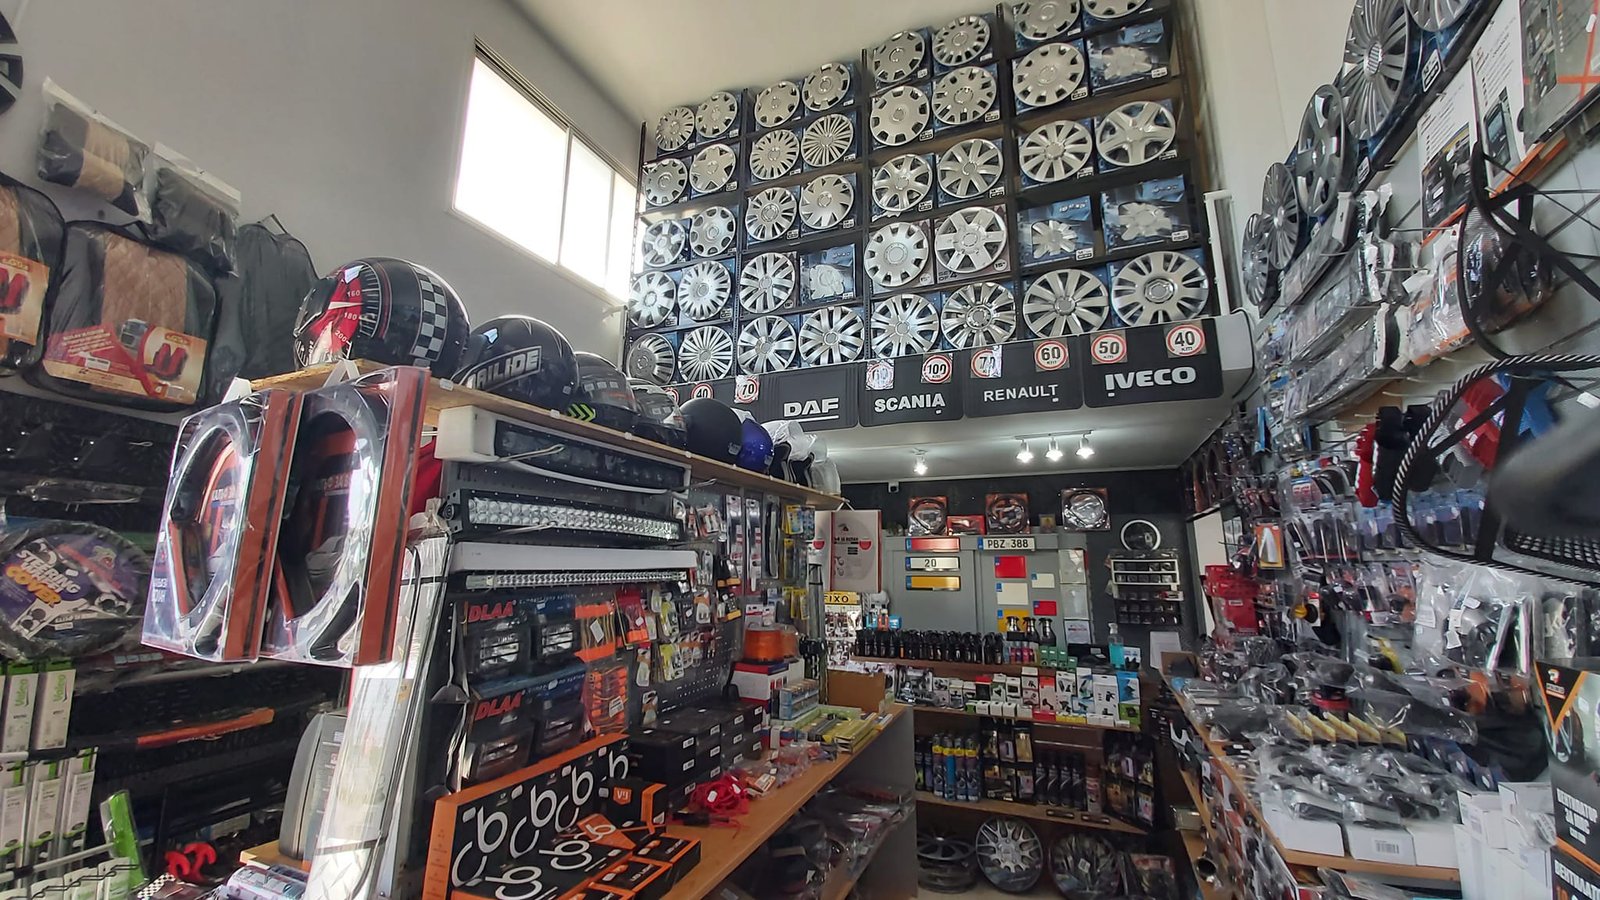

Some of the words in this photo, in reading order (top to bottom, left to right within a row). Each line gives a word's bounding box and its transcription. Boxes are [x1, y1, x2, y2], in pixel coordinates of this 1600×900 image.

[344, 312, 357, 321] 180
[334, 329, 347, 342] 200
[1174, 330, 1195, 346] 40
[1040, 346, 1061, 361] 60
[1098, 341, 1120, 354] 50
[927, 363, 947, 375] 100
[1104, 366, 1196, 391] IVECO
[741, 384, 755, 396] 70
[983, 384, 1059, 402] RENAULT
[783, 397, 839, 417] DAF
[874, 393, 946, 413] SCANIA
[987, 539, 1006, 549] PBZ
[1010, 539, 1029, 548] 388
[16, 549, 81, 594] STEERING
[924, 559, 937, 568] 20
[5, 564, 62, 608] COVER
[468, 601, 514, 623] DLAA
[475, 692, 523, 721] DLAA
